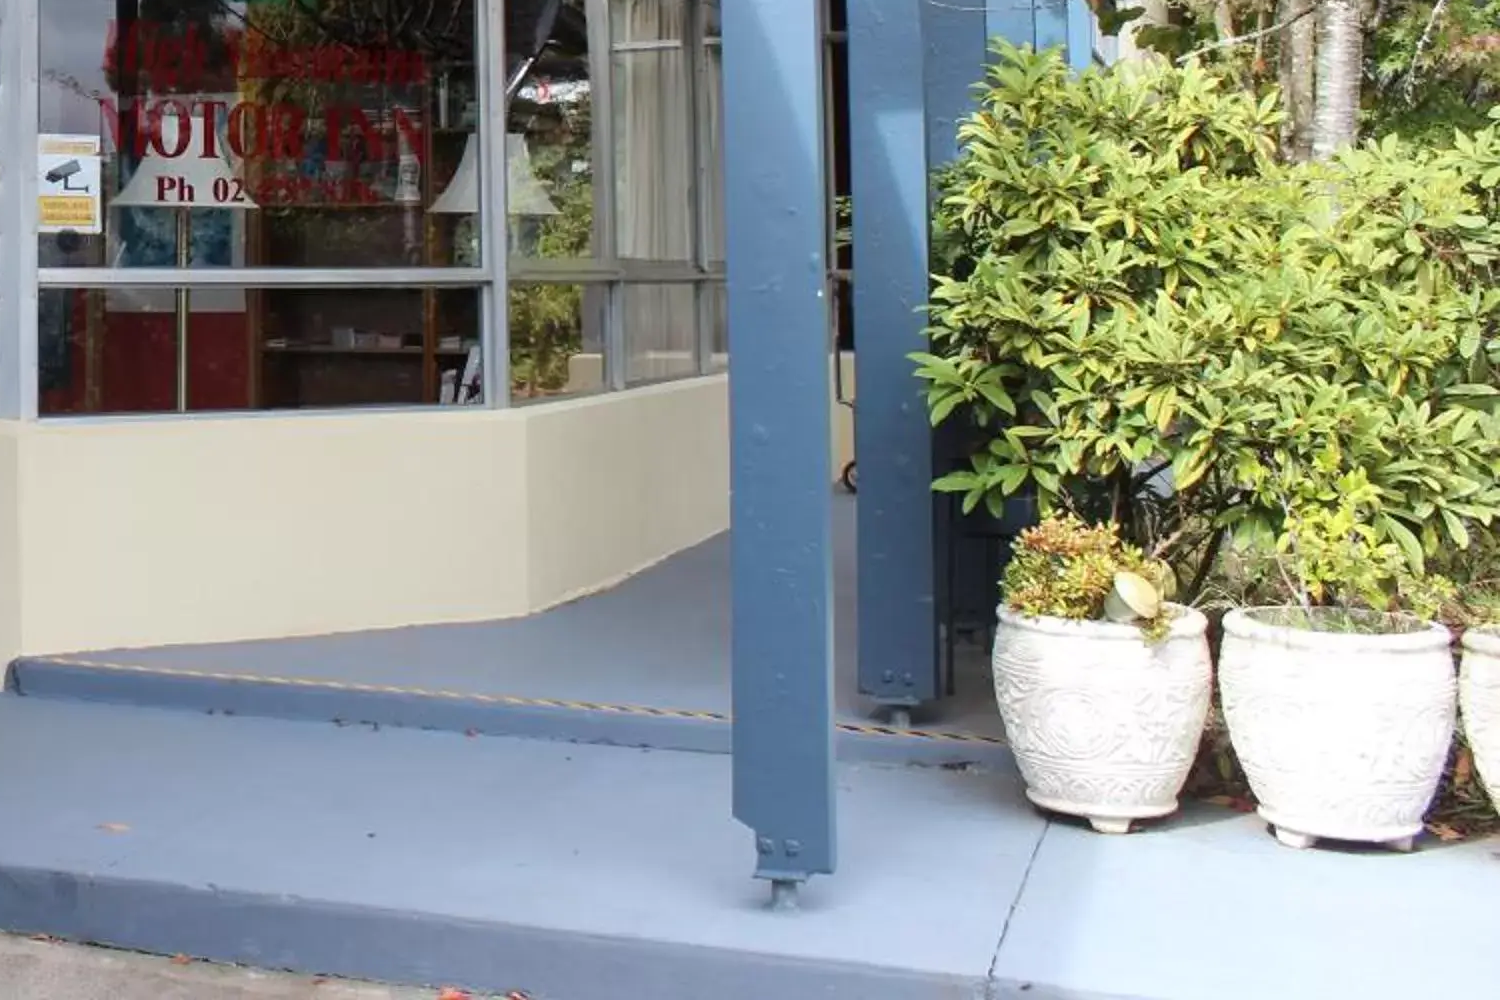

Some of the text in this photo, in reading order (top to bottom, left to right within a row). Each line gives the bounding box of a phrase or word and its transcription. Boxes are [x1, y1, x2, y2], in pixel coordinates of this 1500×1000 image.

[96, 96, 308, 164] MOTOR
[155, 176, 195, 202] Ph
[213, 177, 245, 202] 02
